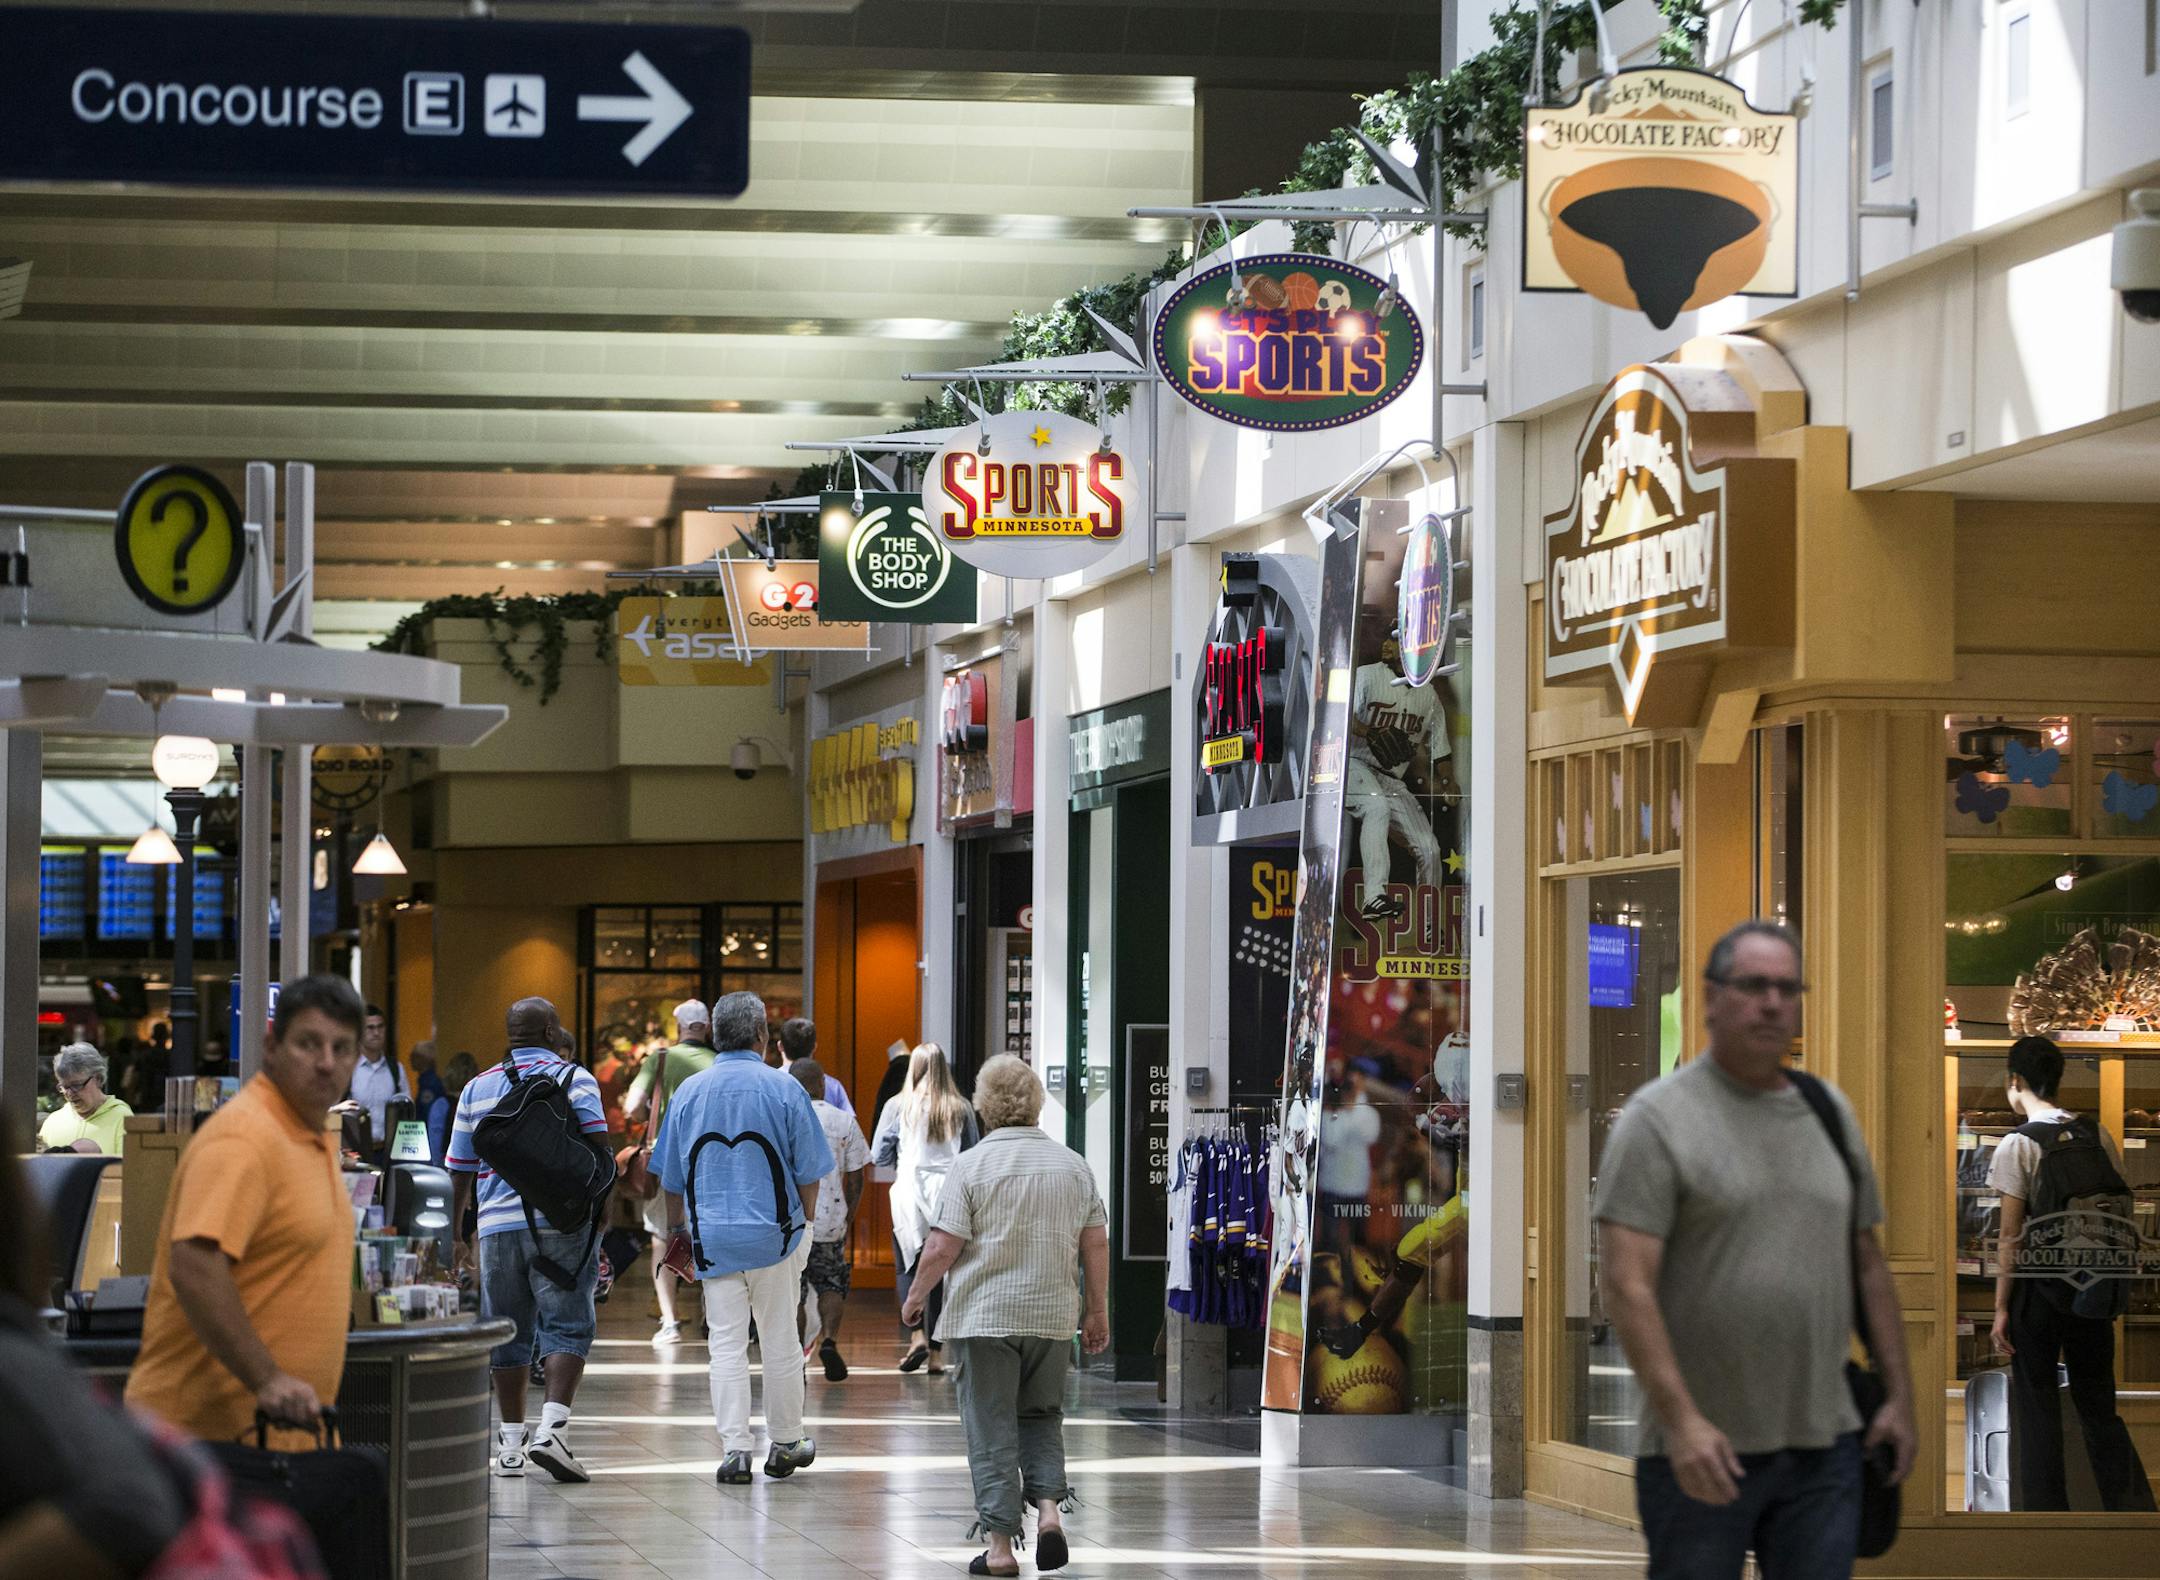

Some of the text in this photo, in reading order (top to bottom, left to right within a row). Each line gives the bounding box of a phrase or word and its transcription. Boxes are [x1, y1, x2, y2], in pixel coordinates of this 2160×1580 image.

[71, 67, 452, 129] Concourse E
[1645, 77, 1739, 120] Mountain
[1188, 331, 1386, 395] SPORTS
[943, 452, 1124, 539] SPORTS
[984, 521, 1084, 532] MINNESOTA
[881, 537, 917, 553] THE
[869, 554, 932, 571] BODY
[872, 572, 928, 590] SHOP
[748, 612, 811, 630] Gadgets
[1367, 702, 1425, 735] Twins
[1333, 1204, 1371, 1218] TWINS
